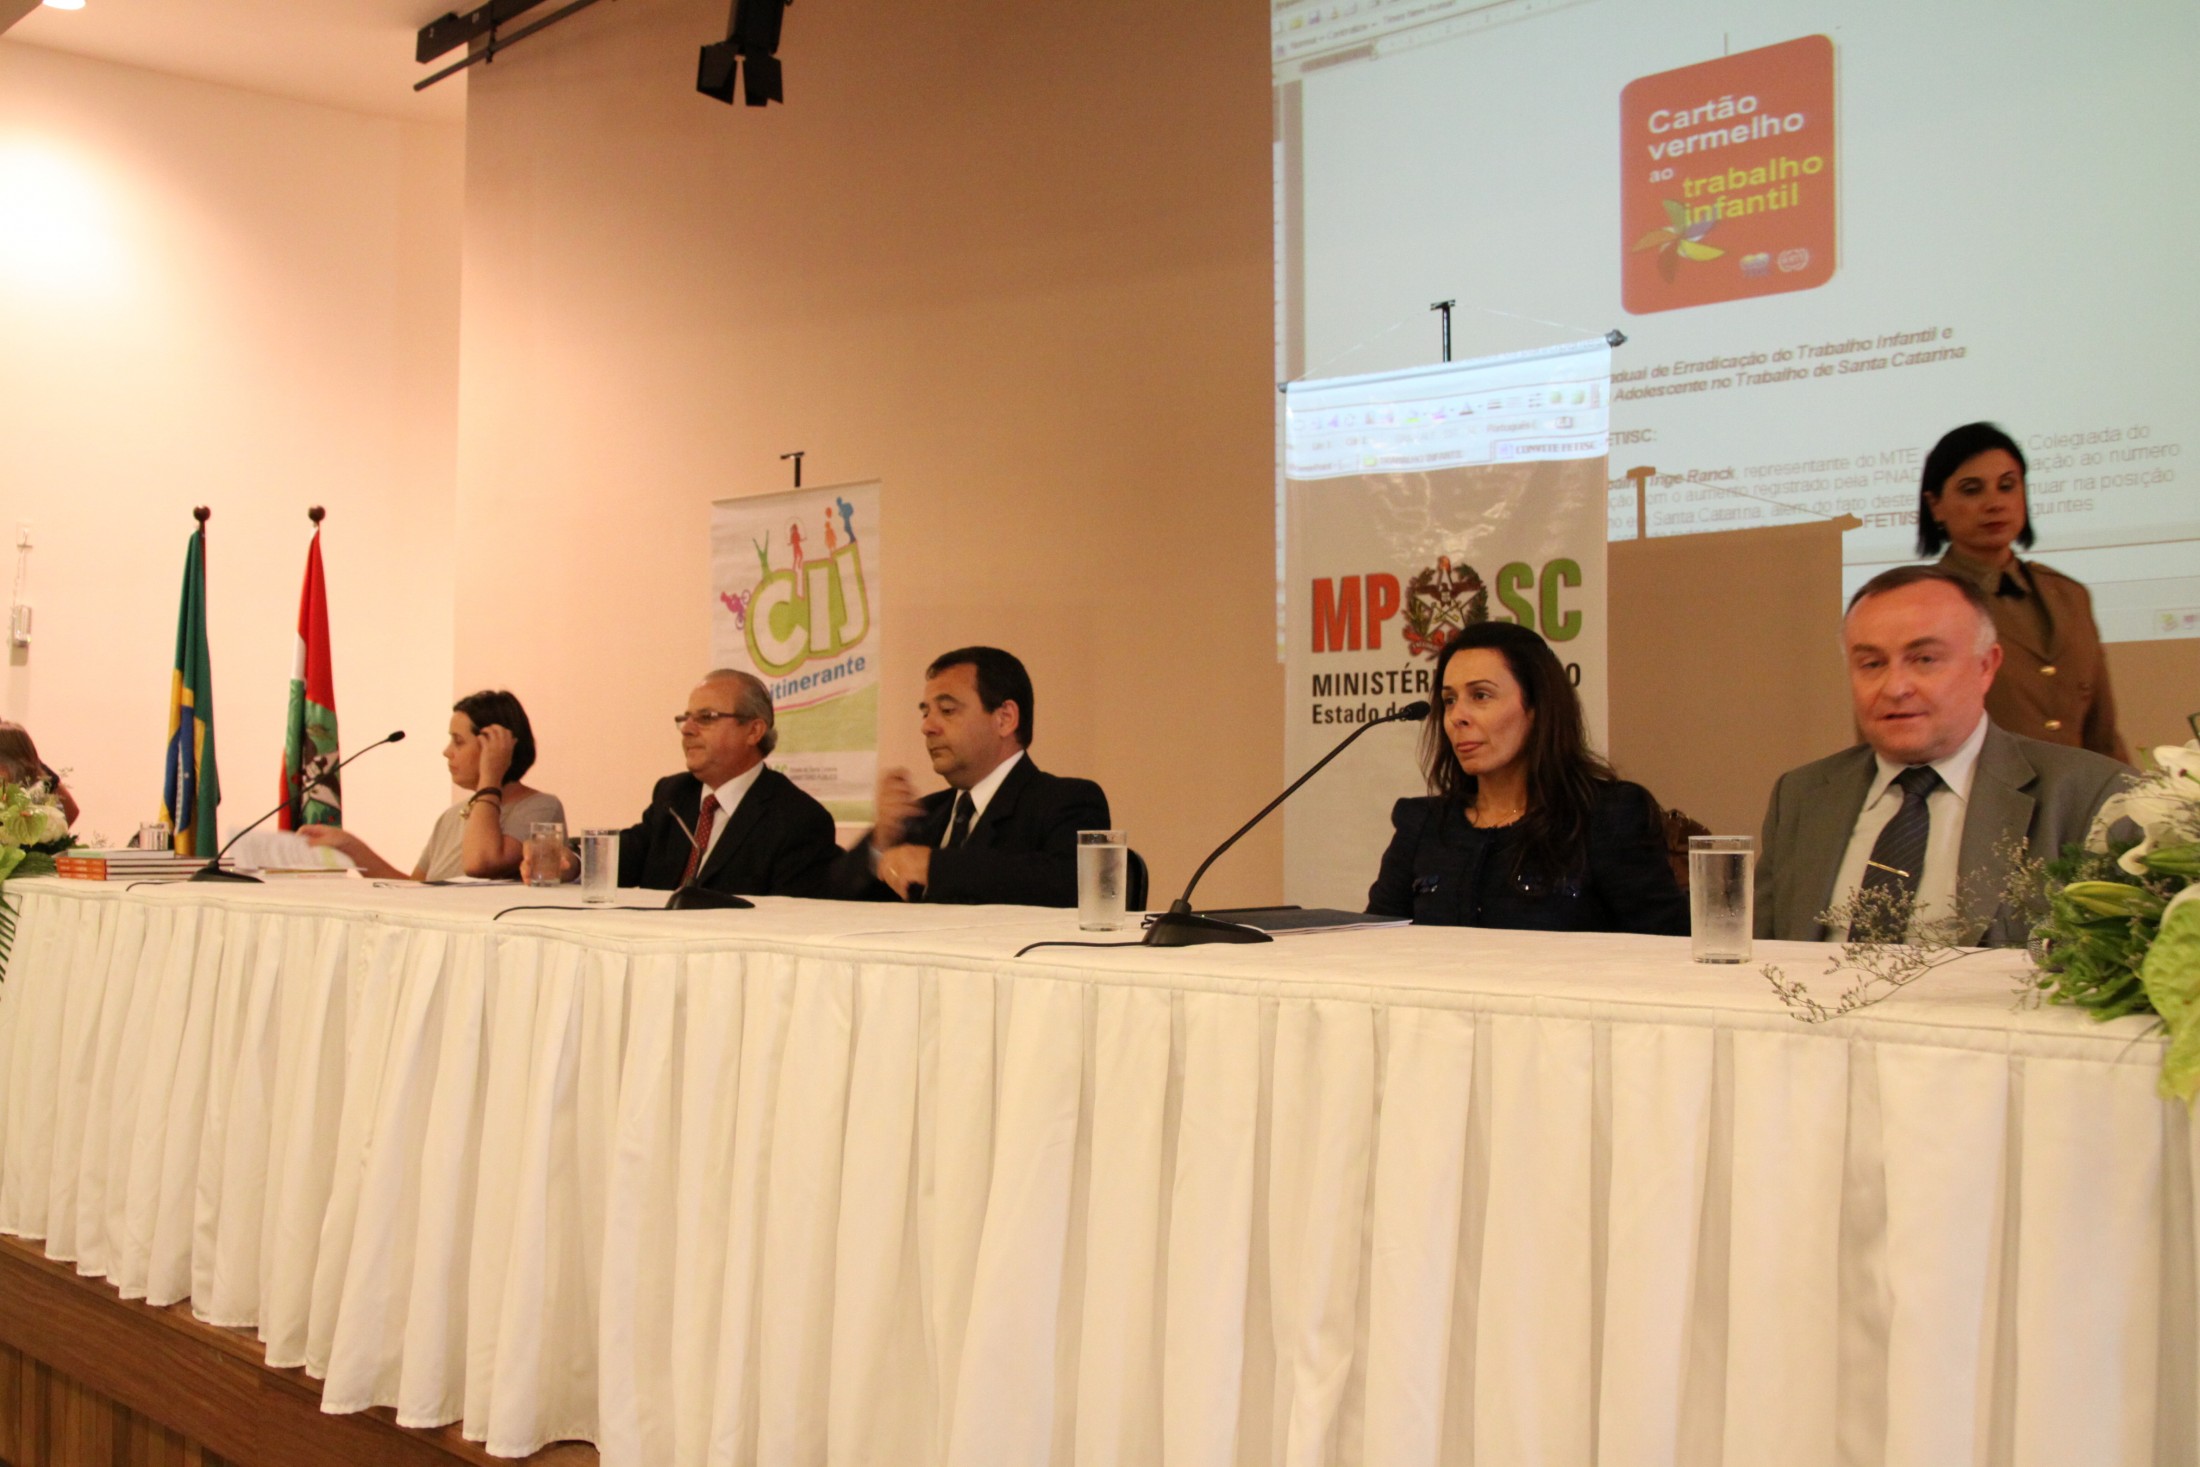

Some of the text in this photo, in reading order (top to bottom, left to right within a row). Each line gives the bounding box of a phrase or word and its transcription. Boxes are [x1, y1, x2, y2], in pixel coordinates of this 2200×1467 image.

[1648, 95, 1758, 134] Cartão
[1648, 112, 1805, 161] vermelho
[1648, 167, 1675, 183] ao
[1683, 155, 1823, 199] trabalho
[1685, 182, 1799, 227] infantil
[1651, 364, 1669, 379] de
[1672, 352, 1767, 376] Erradicação
[1772, 348, 1793, 363] do
[1797, 337, 1873, 359] Trabalho
[1876, 326, 1938, 349] Infantil
[1941, 327, 1953, 340] e
[1614, 345, 1968, 402] Adolescente no Trabalho de Santa Catarina
[2027, 426, 2122, 450] Colegiada
[2126, 424, 2150, 440] do
[1855, 453, 1875, 468] do
[2080, 450, 2103, 467] ao
[2072, 476, 2096, 491] na
[2100, 467, 2175, 491] posição
[1652, 509, 1695, 527] Santa
[748, 546, 867, 672] CIJ
[1311, 557, 1583, 654] MP SC
[769, 656, 866, 701] itinerante
[1312, 662, 1438, 698] MINISTÉR
[1312, 702, 1379, 725] Estado
